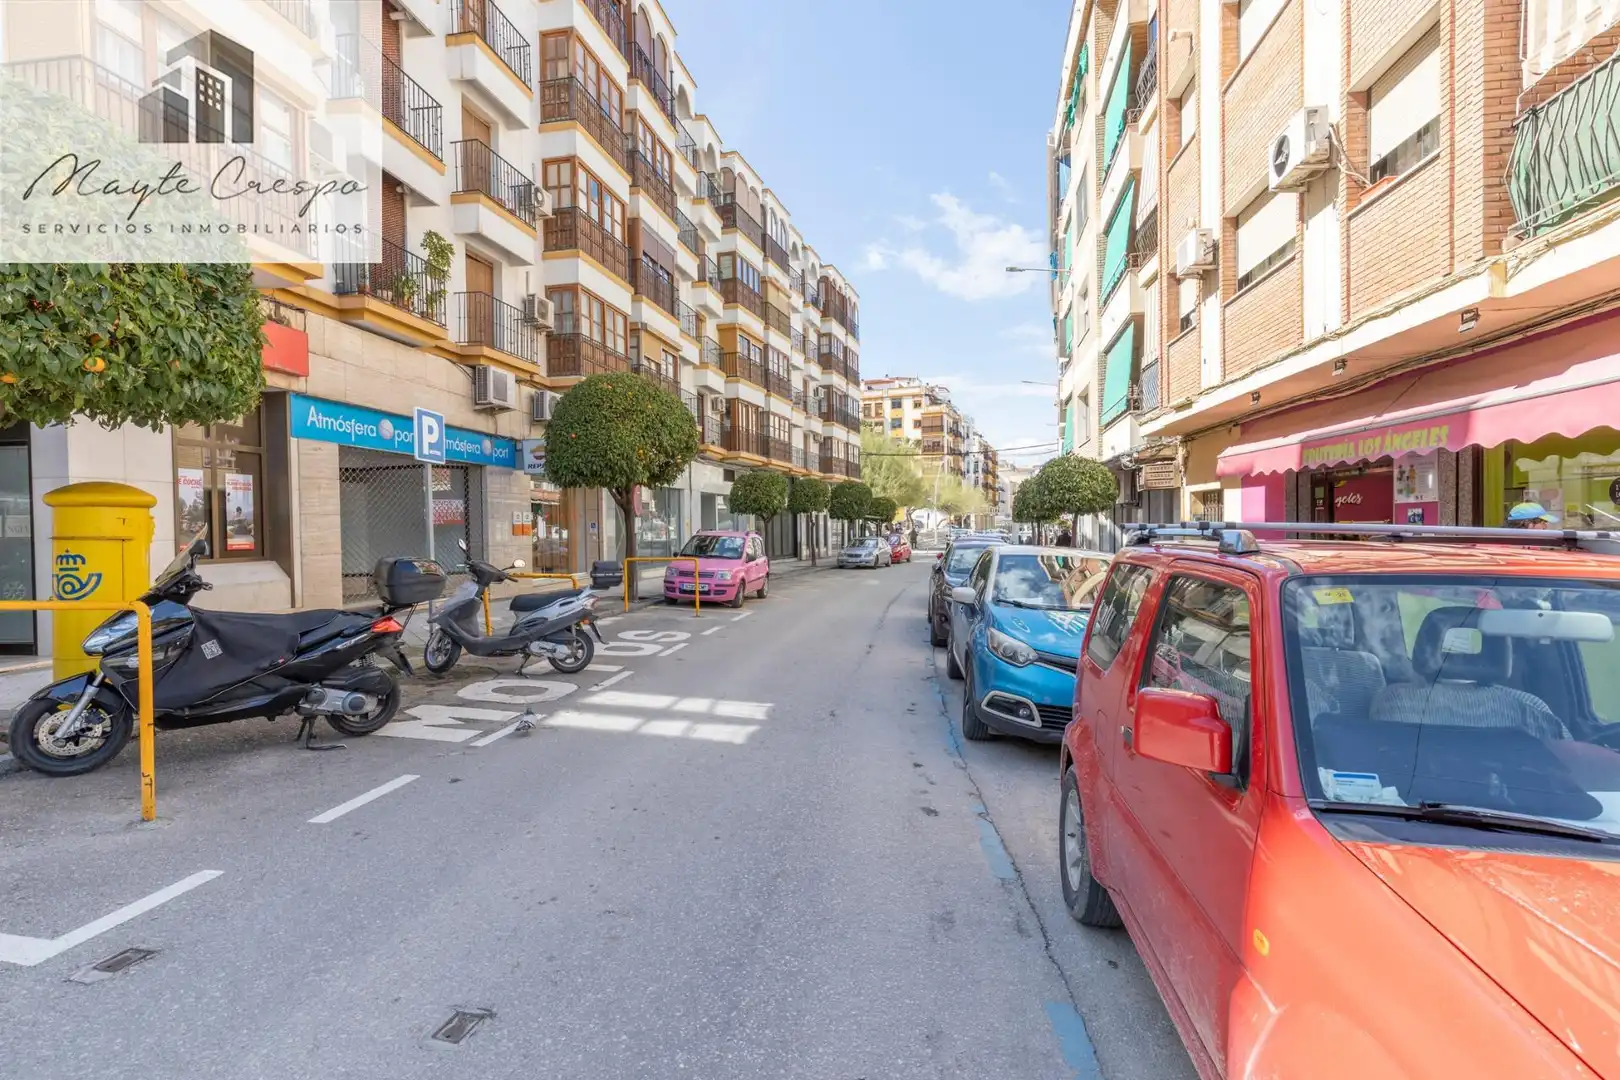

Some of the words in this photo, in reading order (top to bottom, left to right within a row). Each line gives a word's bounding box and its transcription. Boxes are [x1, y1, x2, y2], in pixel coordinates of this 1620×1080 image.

[307, 405, 377, 442] Atmósfera
[394, 428, 414, 449] por
[421, 415, 439, 456] P
[445, 437, 481, 458] mósfera
[1359, 437, 1381, 455] LOS
[1335, 492, 1363, 507] geles
